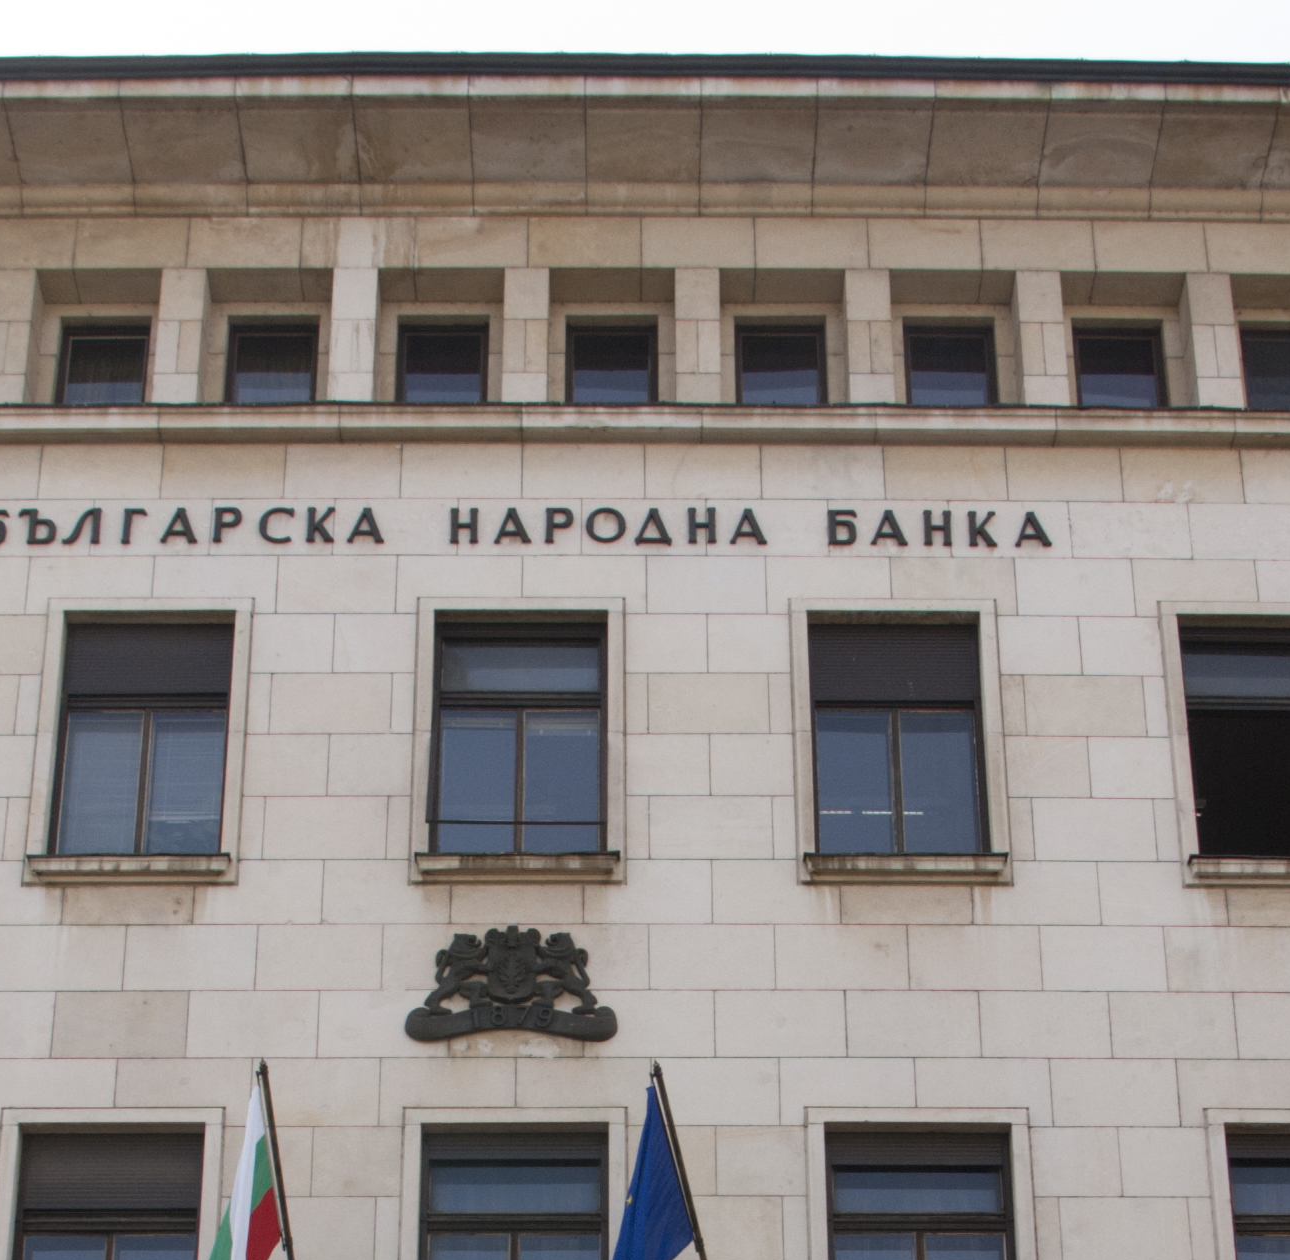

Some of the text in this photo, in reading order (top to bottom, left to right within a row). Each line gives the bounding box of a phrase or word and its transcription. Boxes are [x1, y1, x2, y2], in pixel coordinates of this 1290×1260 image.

[448, 505, 769, 548] НАРОДНА
[825, 508, 1054, 550] БАНКА
[470, 1004, 554, 1029] 1879
